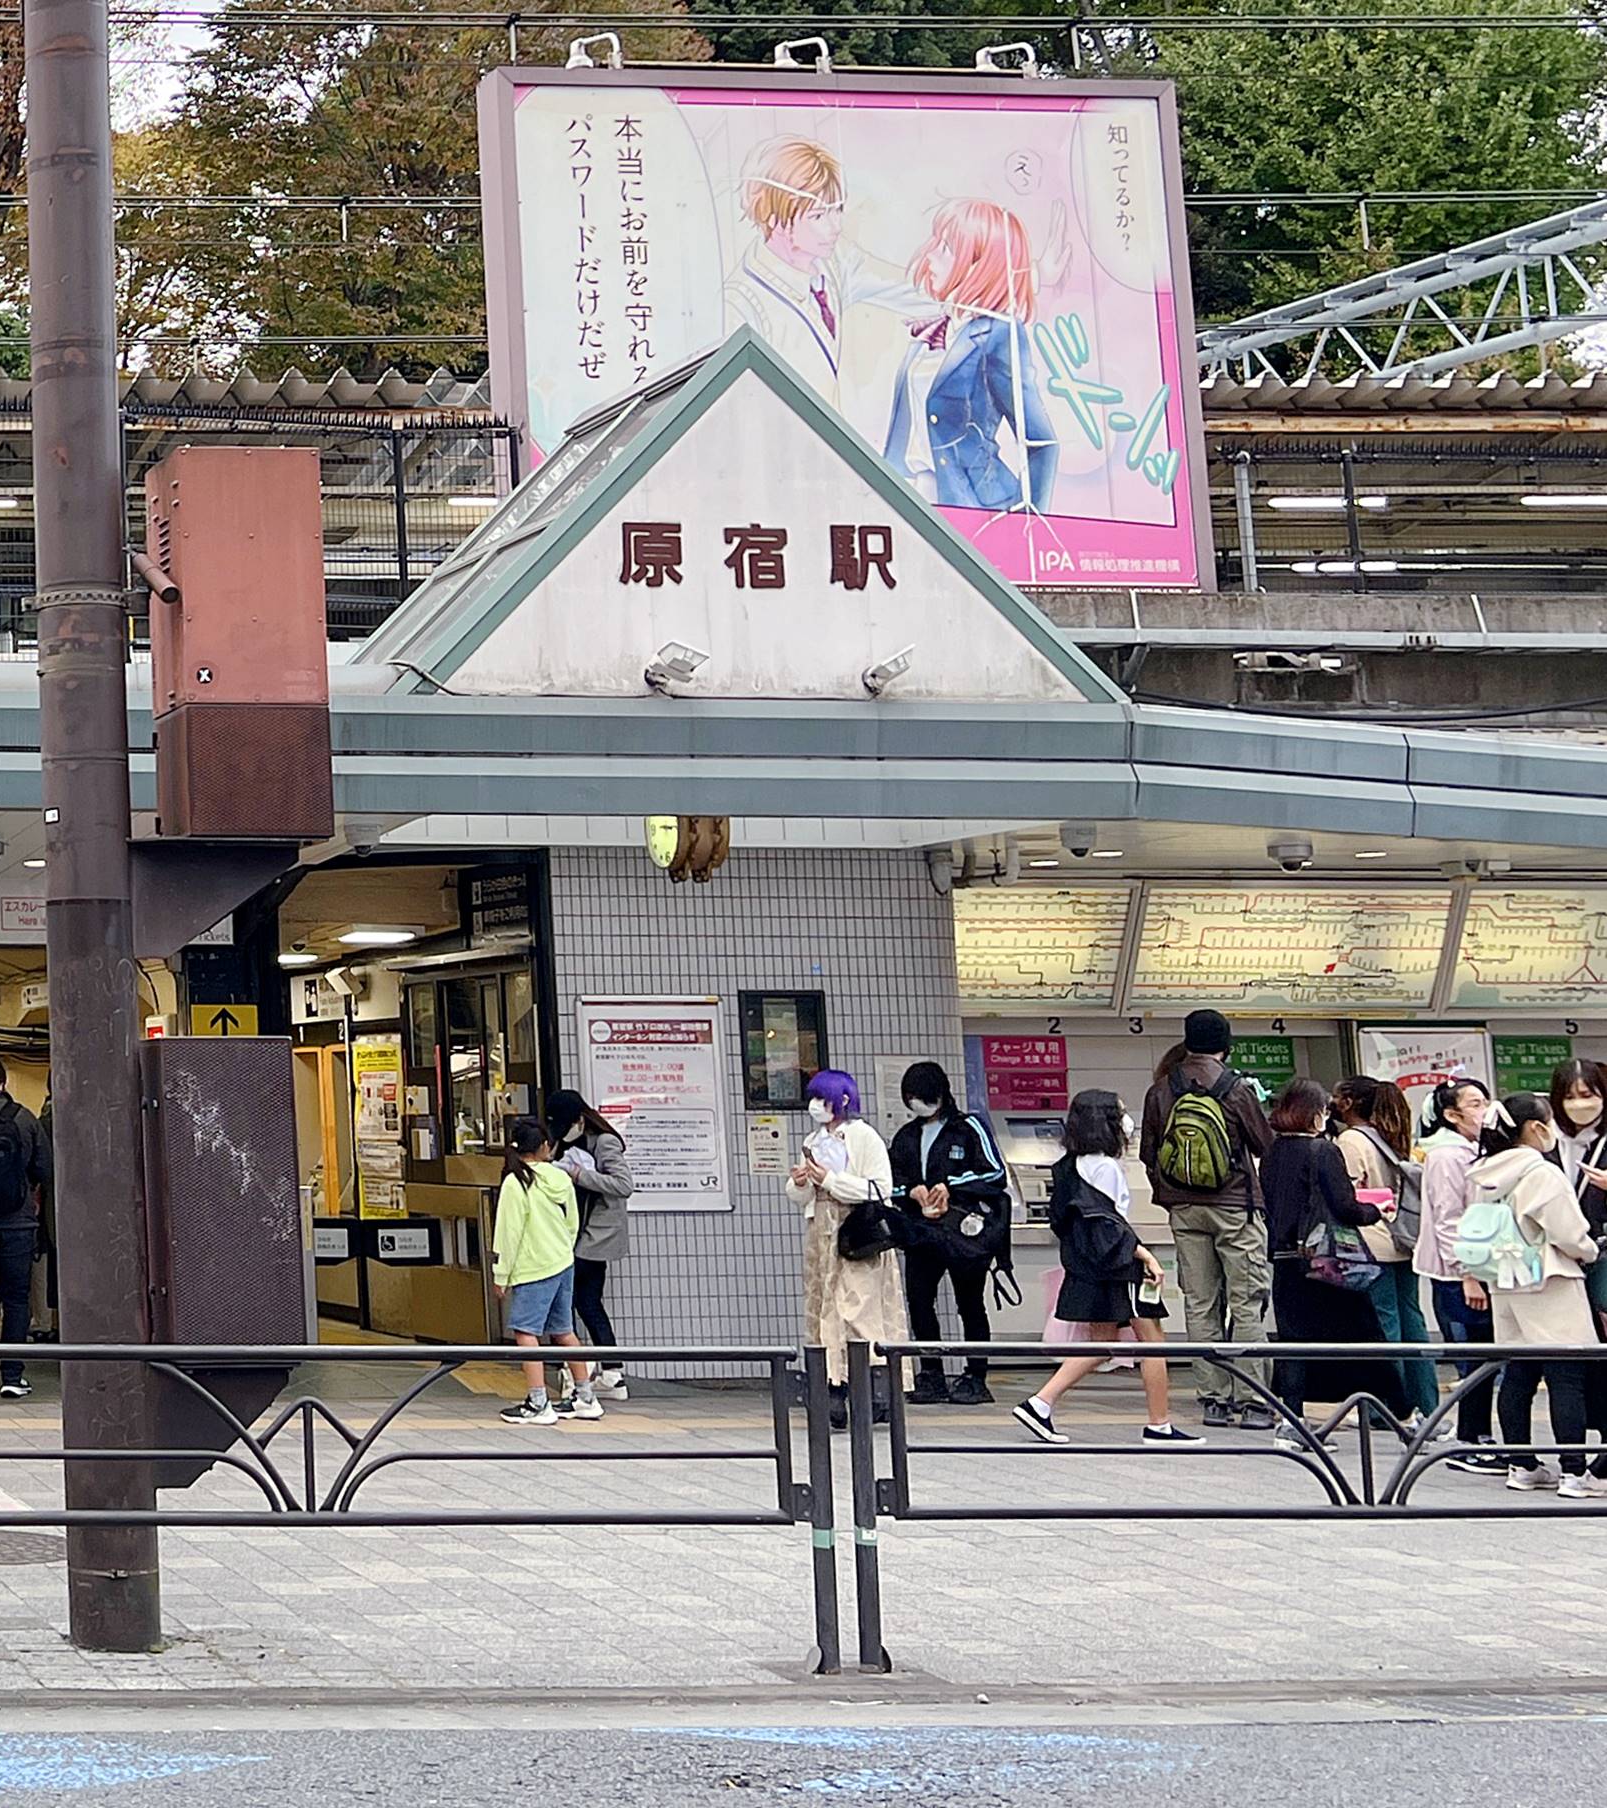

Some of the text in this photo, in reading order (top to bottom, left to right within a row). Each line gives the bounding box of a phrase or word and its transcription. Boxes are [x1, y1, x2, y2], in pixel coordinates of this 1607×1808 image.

[1107, 124, 1135, 251] 知ってるか？
[565, 113, 606, 380] パスワードだけだぜ
[619, 522, 896, 590] 原宿駅
[1039, 551, 1075, 572] IPA
[1048, 1017, 1062, 1034] 2
[1129, 1017, 1143, 1034] 3
[1272, 1018, 1286, 1034] 4
[1566, 1018, 1578, 1034] 5
[990, 1042, 1059, 1054] チャージ専用
[1250, 1043, 1289, 1053] Tickets
[1528, 1044, 1567, 1054] Tickets
[990, 1055, 1020, 1064] Charge
